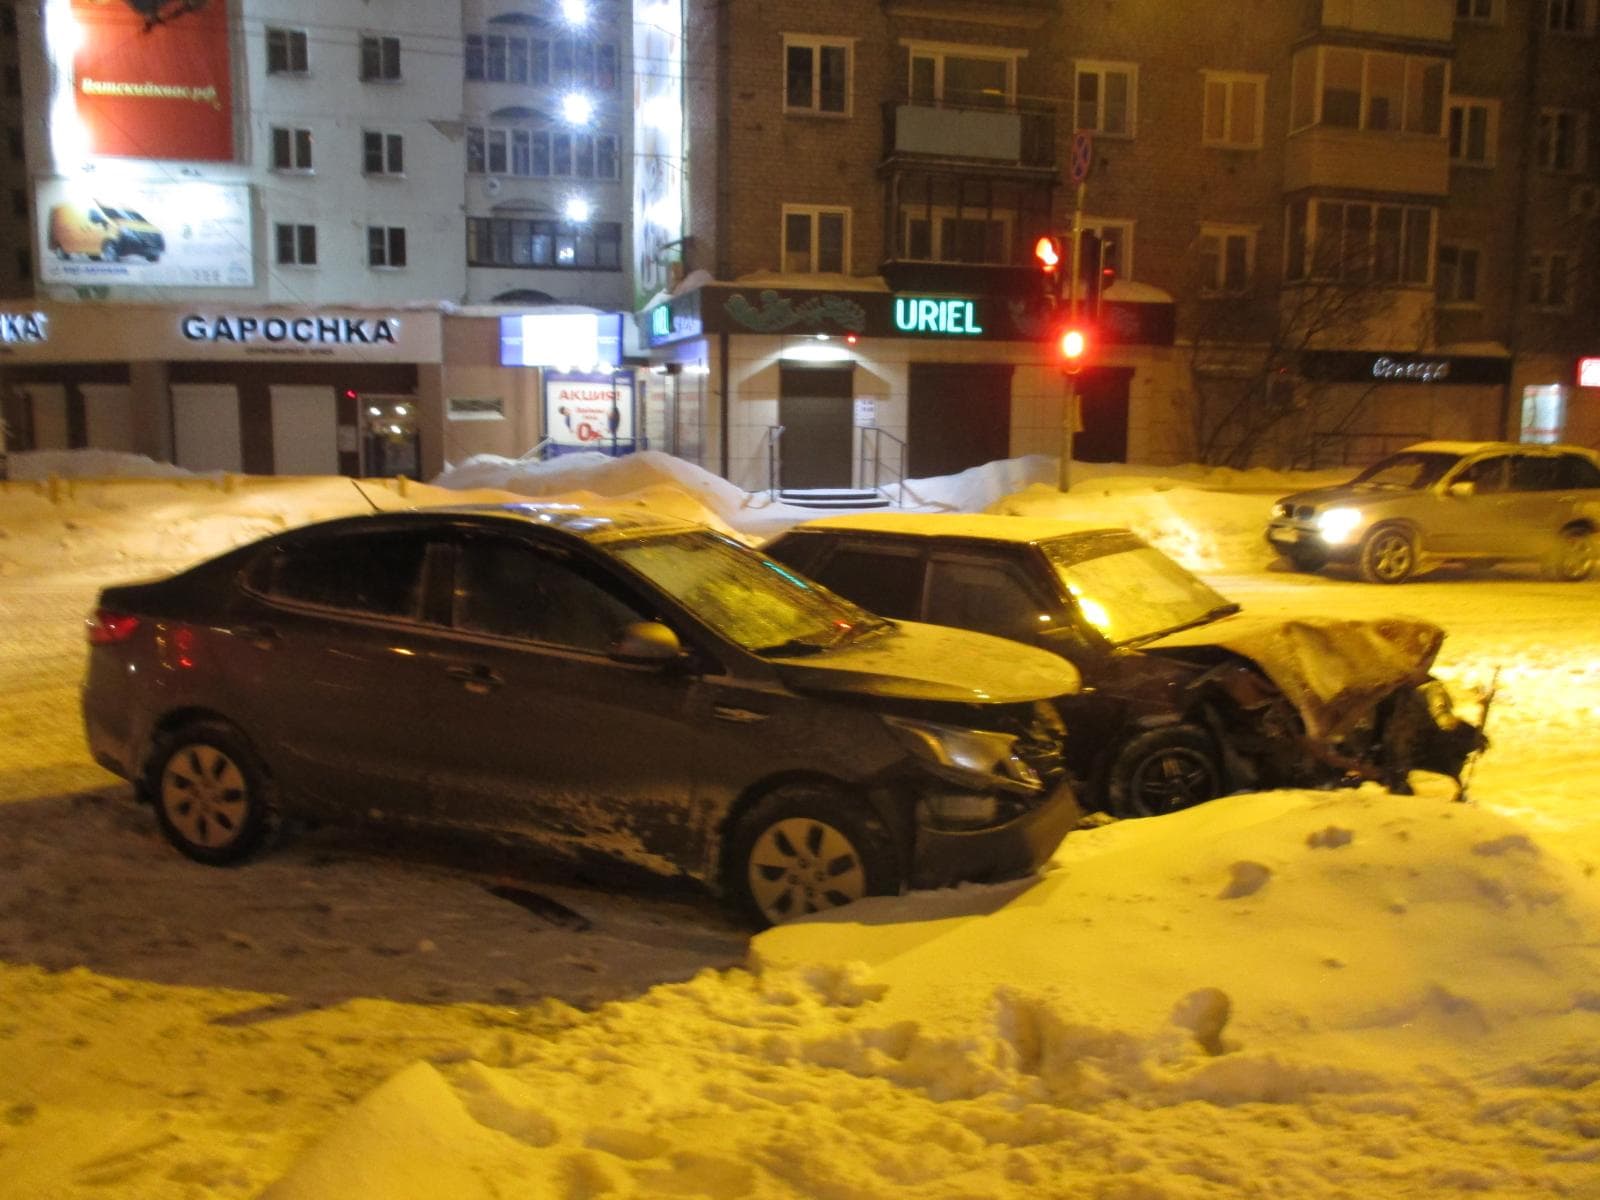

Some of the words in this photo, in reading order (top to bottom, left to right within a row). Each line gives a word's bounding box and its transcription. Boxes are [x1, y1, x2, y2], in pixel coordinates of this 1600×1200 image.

[0, 312, 43, 342] KA
[182, 315, 398, 344] GAPOCHKA
[894, 298, 983, 335] URIEL
[559, 389, 622, 401] АКЦИЯ!
